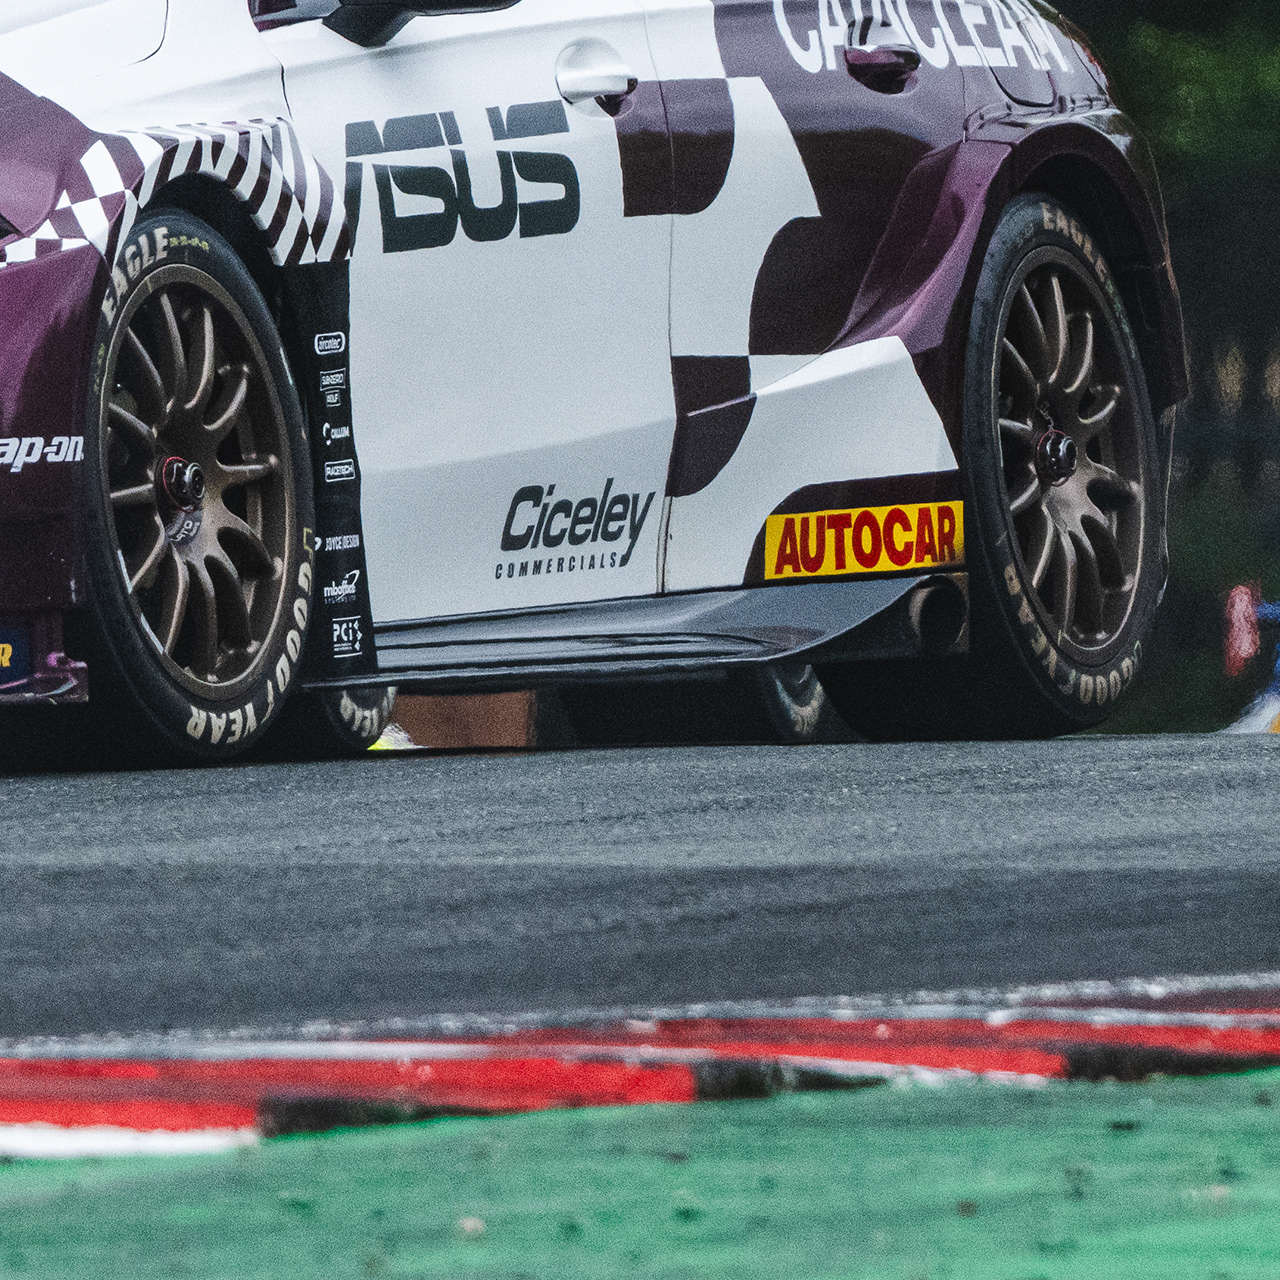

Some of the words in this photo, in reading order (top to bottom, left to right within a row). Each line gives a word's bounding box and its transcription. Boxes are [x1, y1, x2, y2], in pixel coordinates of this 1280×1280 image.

[344, 99, 581, 256] ASUS
[101, 226, 170, 326] EAGLE
[495, 551, 619, 580] COMMERCIALS
[500, 478, 655, 568] Ciceley
[774, 504, 956, 576] AUTOCAR
